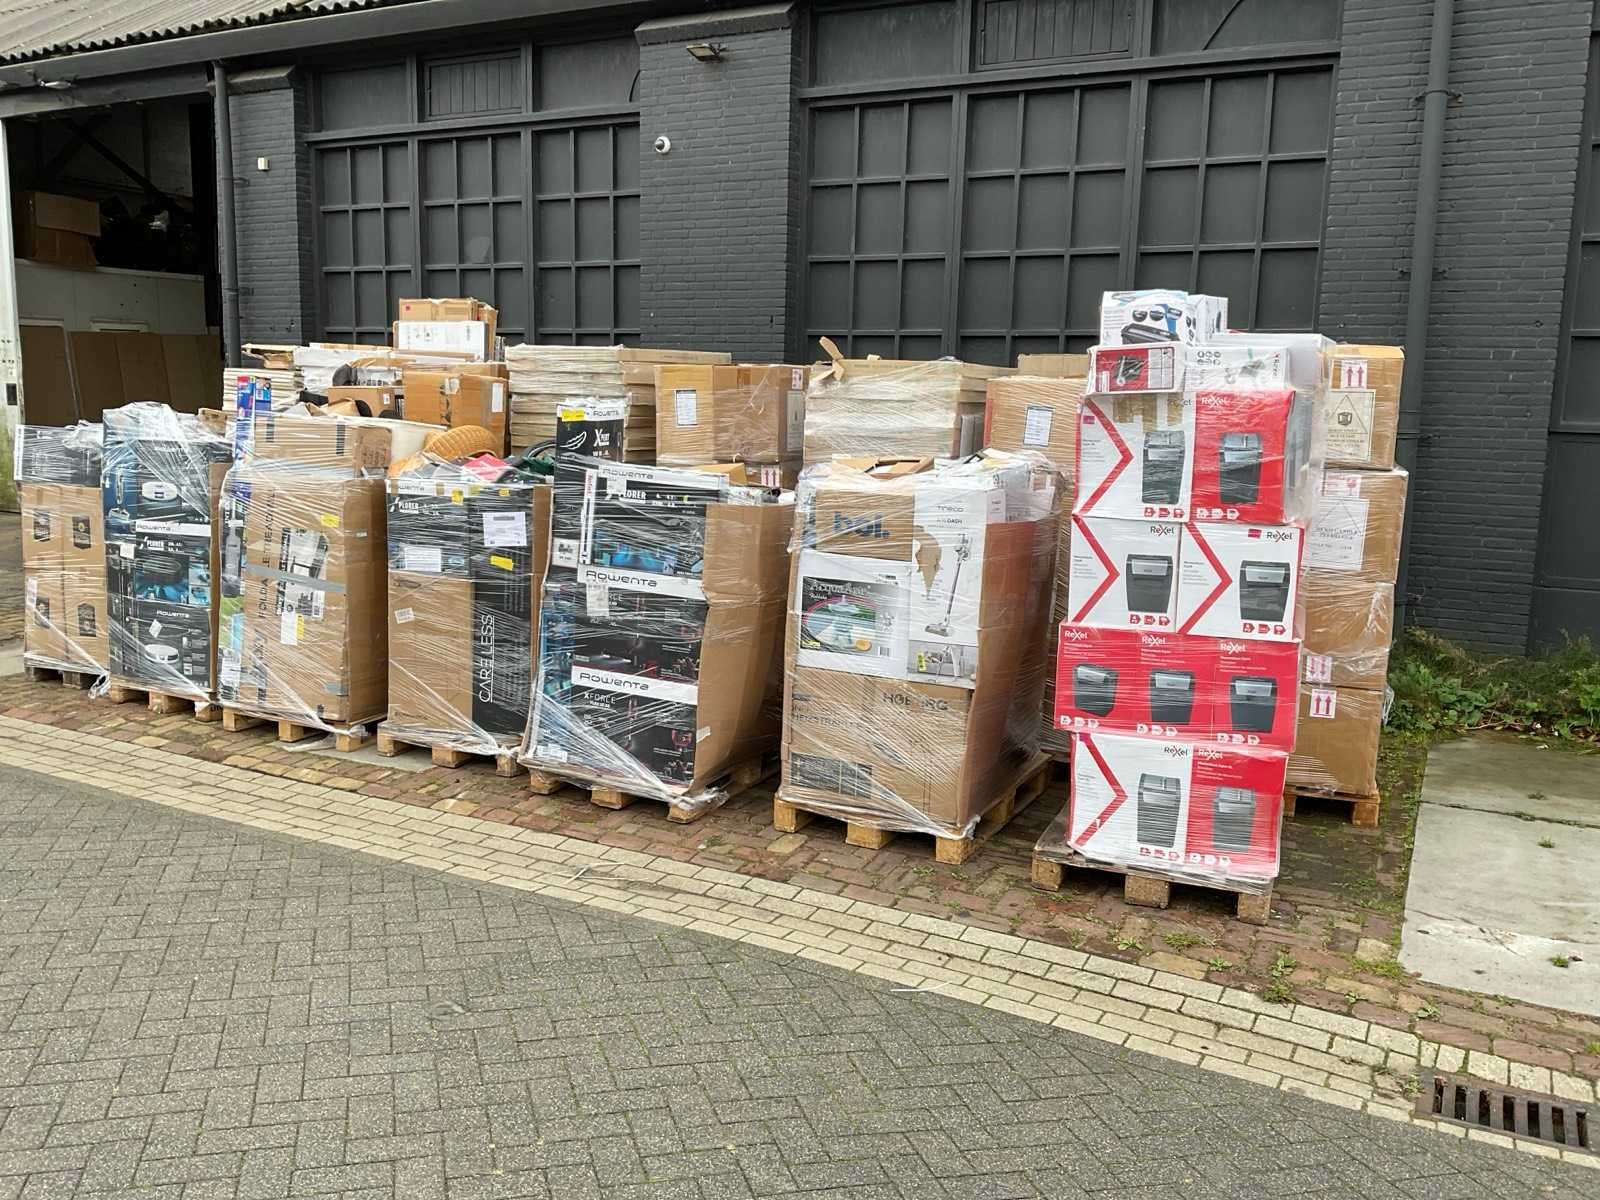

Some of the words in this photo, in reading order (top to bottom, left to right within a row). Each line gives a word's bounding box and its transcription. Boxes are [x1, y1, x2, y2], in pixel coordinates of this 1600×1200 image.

[602, 468, 654, 480] ROWENTA
[1150, 523, 1176, 537] Rexel
[1266, 529, 1293, 543] Rexel
[586, 569, 658, 588] ROWENTA
[1064, 628, 1088, 642] Rexel
[1142, 634, 1166, 647] Rexel
[579, 672, 650, 691] ROWENTA
[1164, 745, 1188, 757] Rexel
[1198, 747, 1224, 760] Rexel
